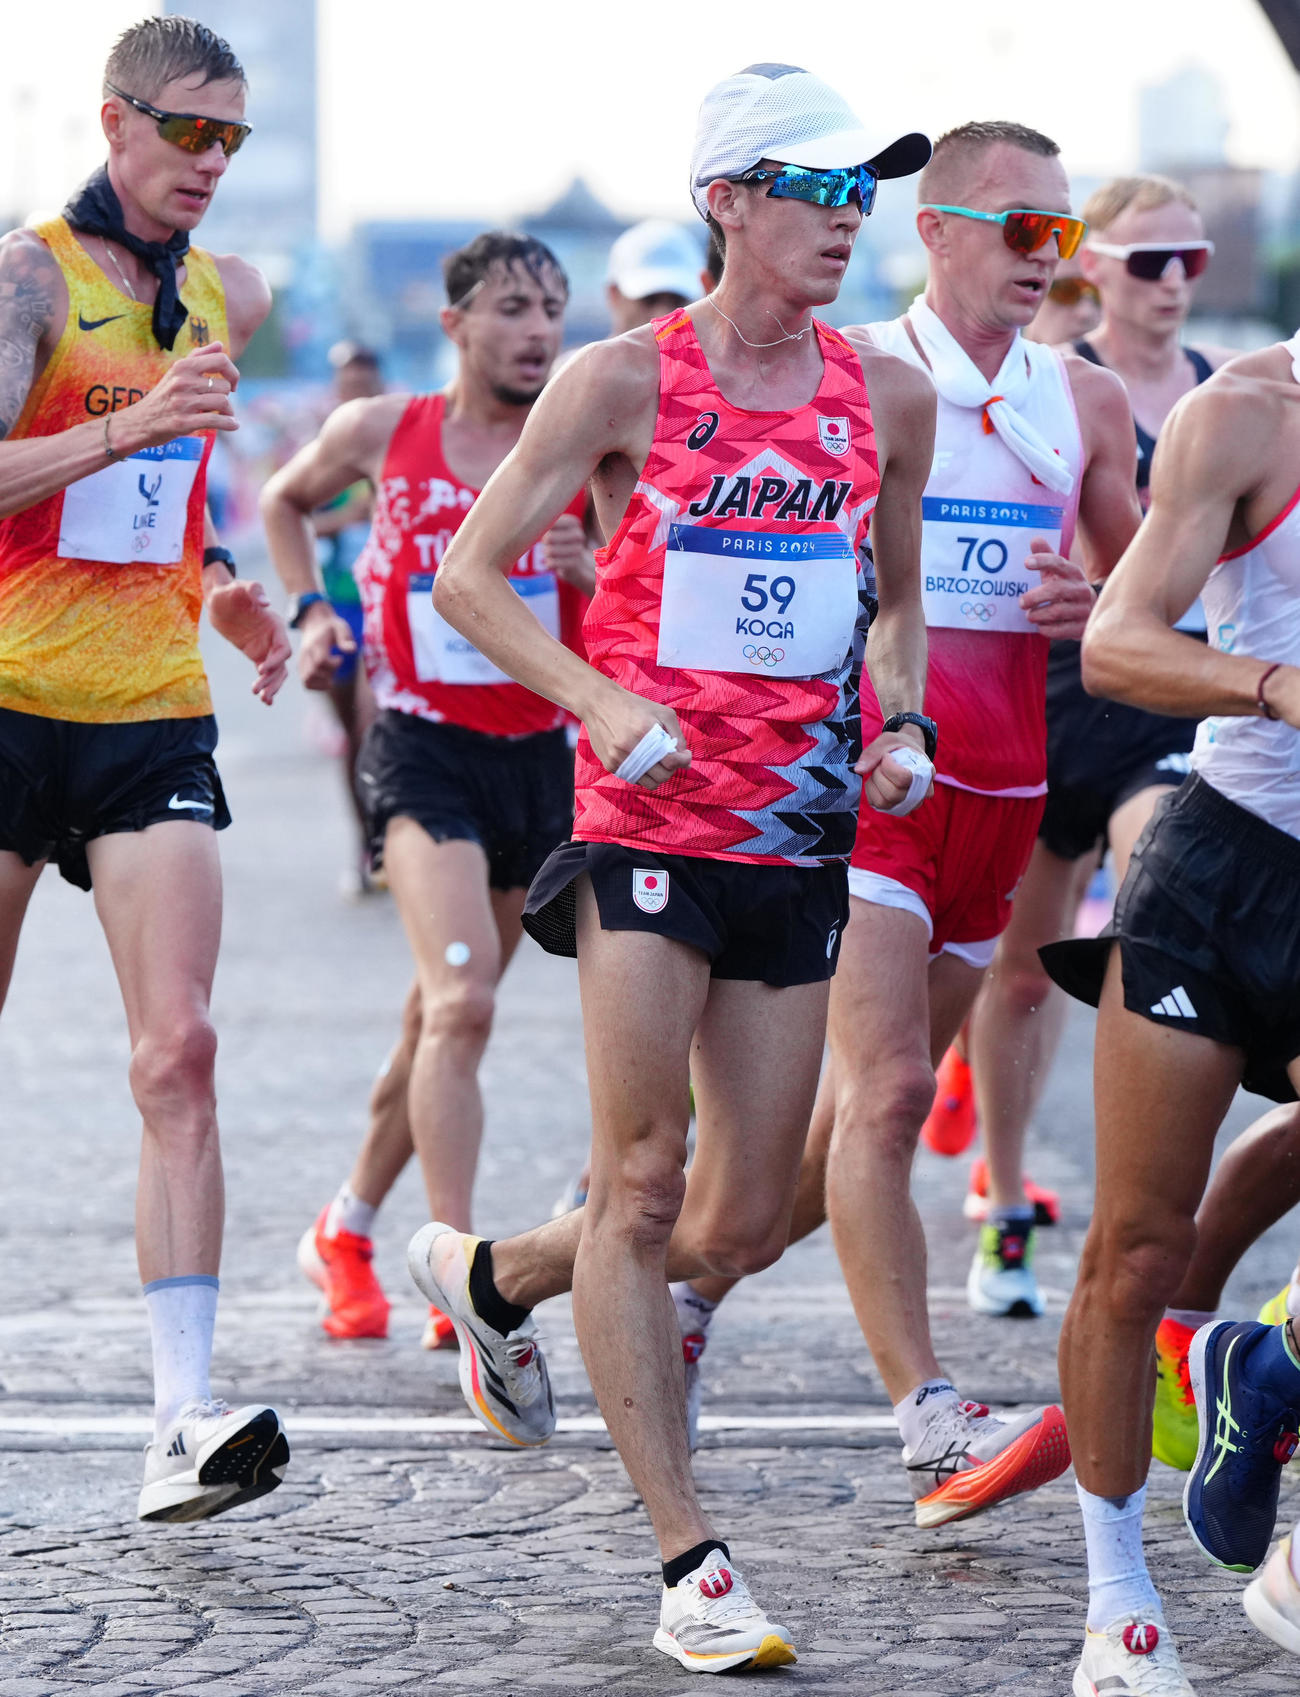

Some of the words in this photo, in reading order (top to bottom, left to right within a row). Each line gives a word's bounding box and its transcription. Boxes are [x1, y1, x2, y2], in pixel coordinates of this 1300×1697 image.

[688, 475, 853, 523] JAPAN
[941, 503, 986, 518] PARIS
[990, 507, 1028, 521] 2024
[722, 537, 773, 553] PARIS
[779, 541, 816, 554] 2024
[957, 536, 1008, 574] 70
[741, 573, 796, 615] 59
[925, 576, 1030, 598] BRZOZOWSKI
[735, 617, 794, 639] KOGA
